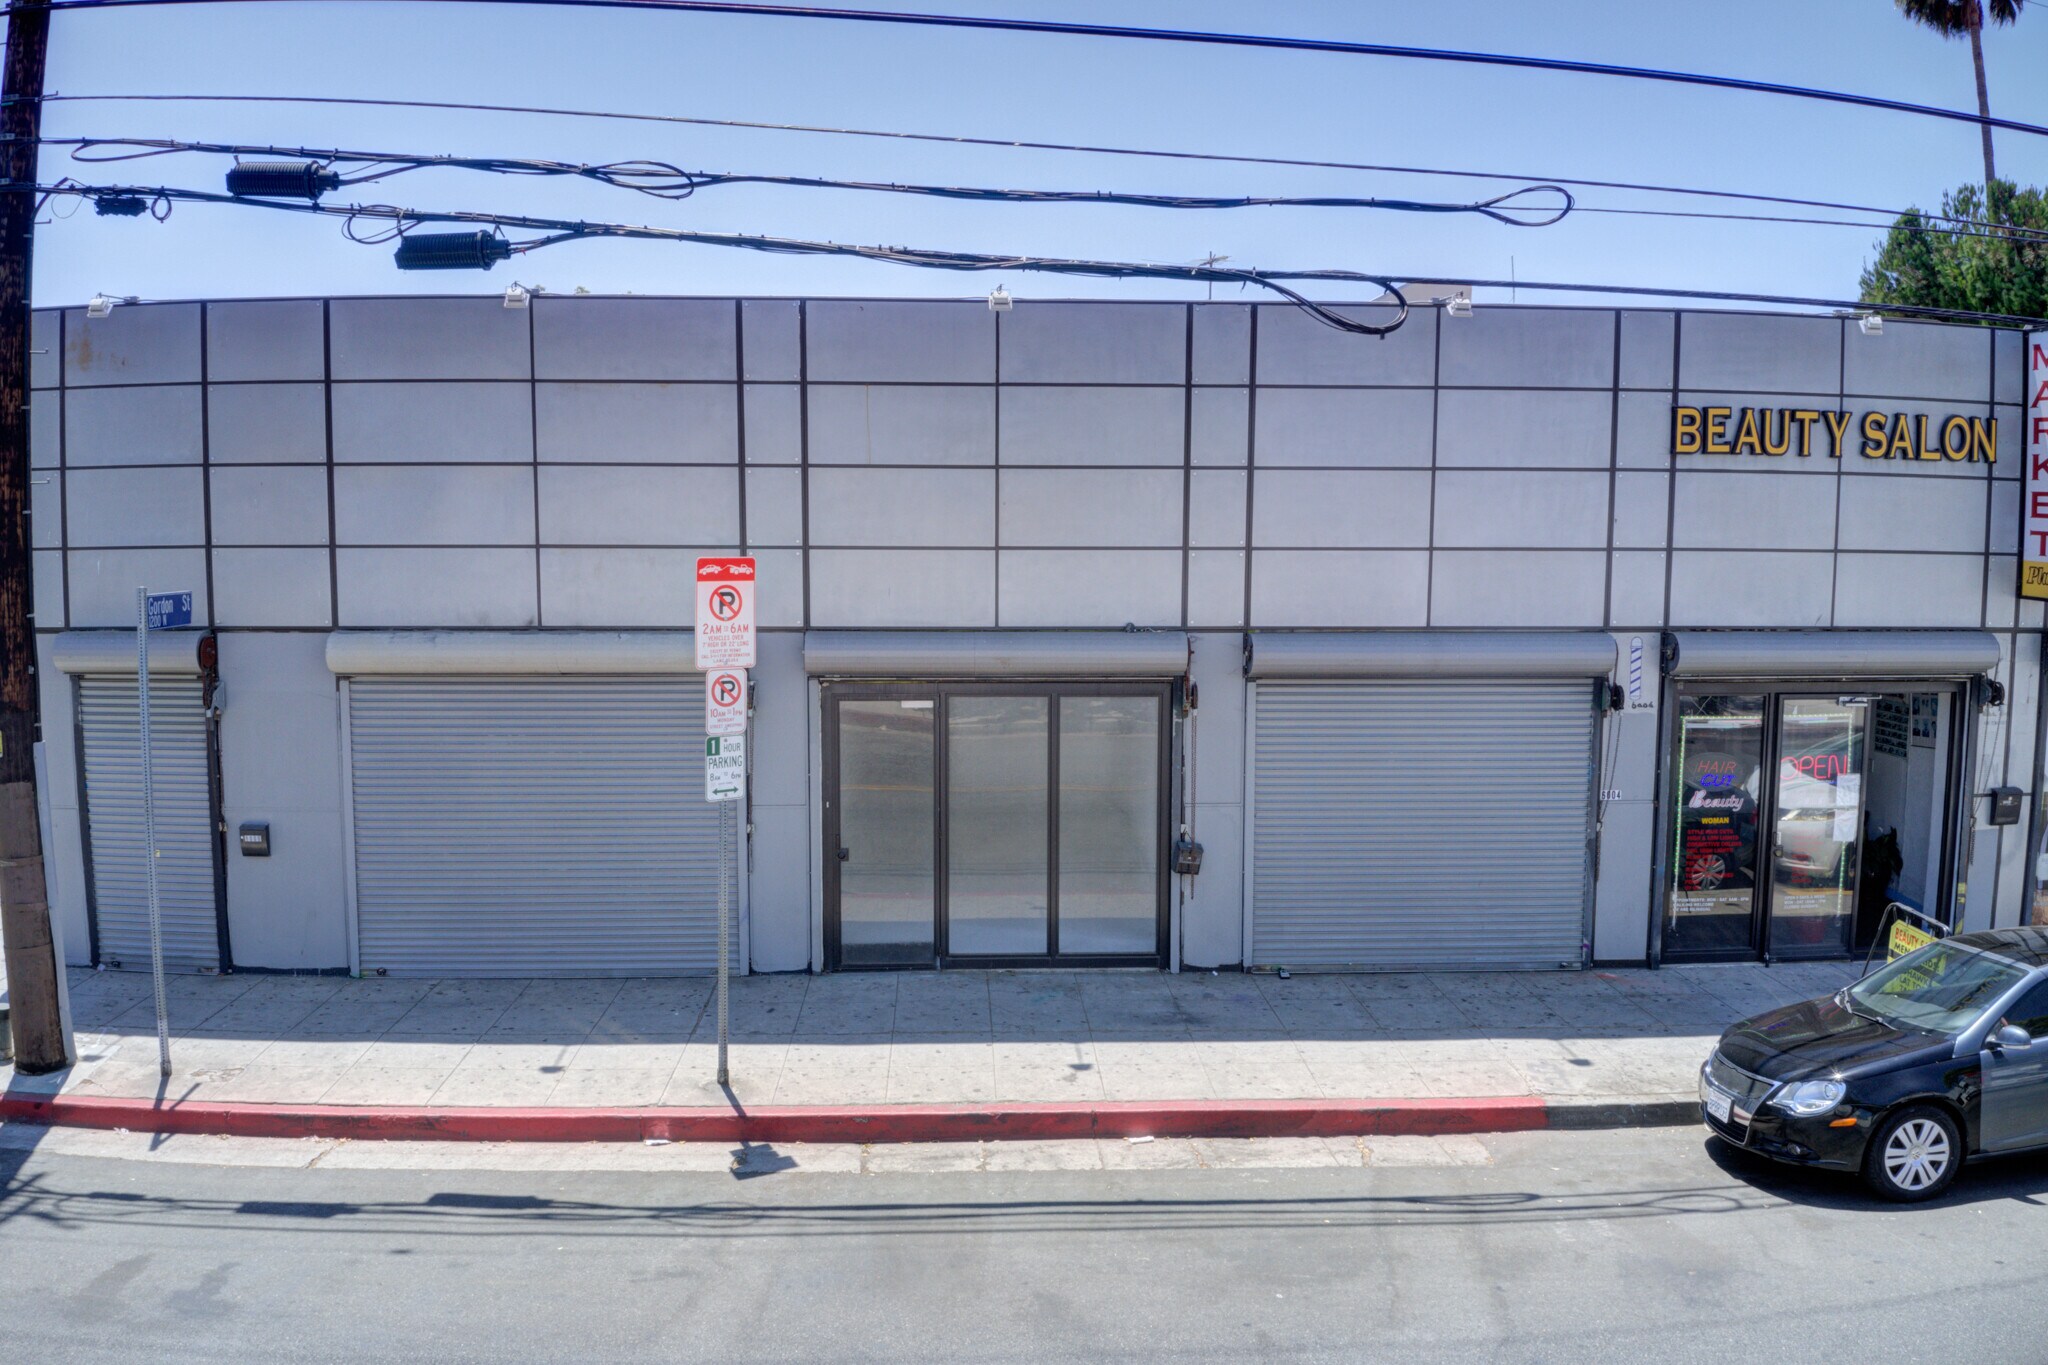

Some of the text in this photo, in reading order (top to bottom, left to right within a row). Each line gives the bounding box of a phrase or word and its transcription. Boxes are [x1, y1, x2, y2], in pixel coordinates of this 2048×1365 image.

[1671, 406, 1998, 463] BEAUTY SALON
[148, 594, 190, 615] Gordon St
[149, 614, 167, 628] 1200 N
[702, 623, 721, 634] 2AM
[731, 622, 749, 633] 6AM
[710, 708, 726, 717] 10AM
[732, 707, 743, 716] 1PM
[711, 740, 741, 754] 1 HOUR
[708, 755, 743, 769] PARKING
[1697, 760, 1737, 773] HAIR
[1779, 754, 1848, 780] OPEN
[710, 773, 720, 781] 8AM
[730, 771, 741, 779] 6PM
[1701, 773, 1736, 787] CUT
[1601, 790, 1621, 800] 6004
[1688, 789, 1744, 812] Beauty
[1701, 816, 1730, 825] WOMAN
[1895, 927, 1918, 949] BEAUTY
